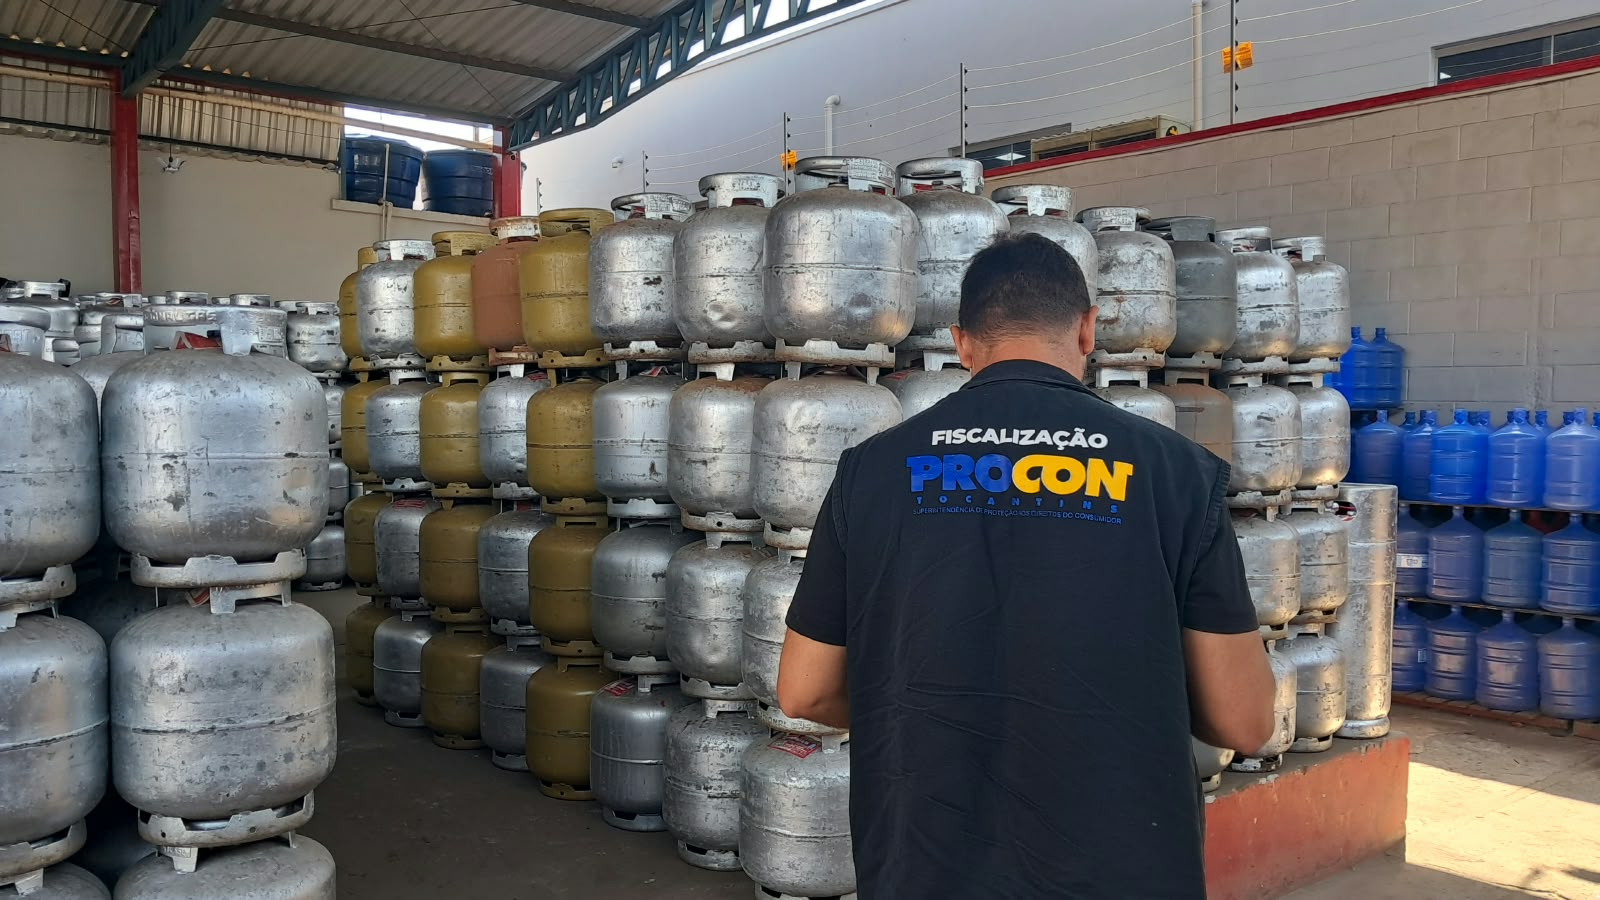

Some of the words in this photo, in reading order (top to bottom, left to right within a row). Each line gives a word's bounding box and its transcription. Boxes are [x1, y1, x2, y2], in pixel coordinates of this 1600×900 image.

[931, 427, 1109, 450] FISCALIZAÇÃO
[906, 453, 1134, 501] PROCON
[916, 495, 1118, 513] TOCANTINS
[1074, 512, 1122, 525] CONSUMIDOR
